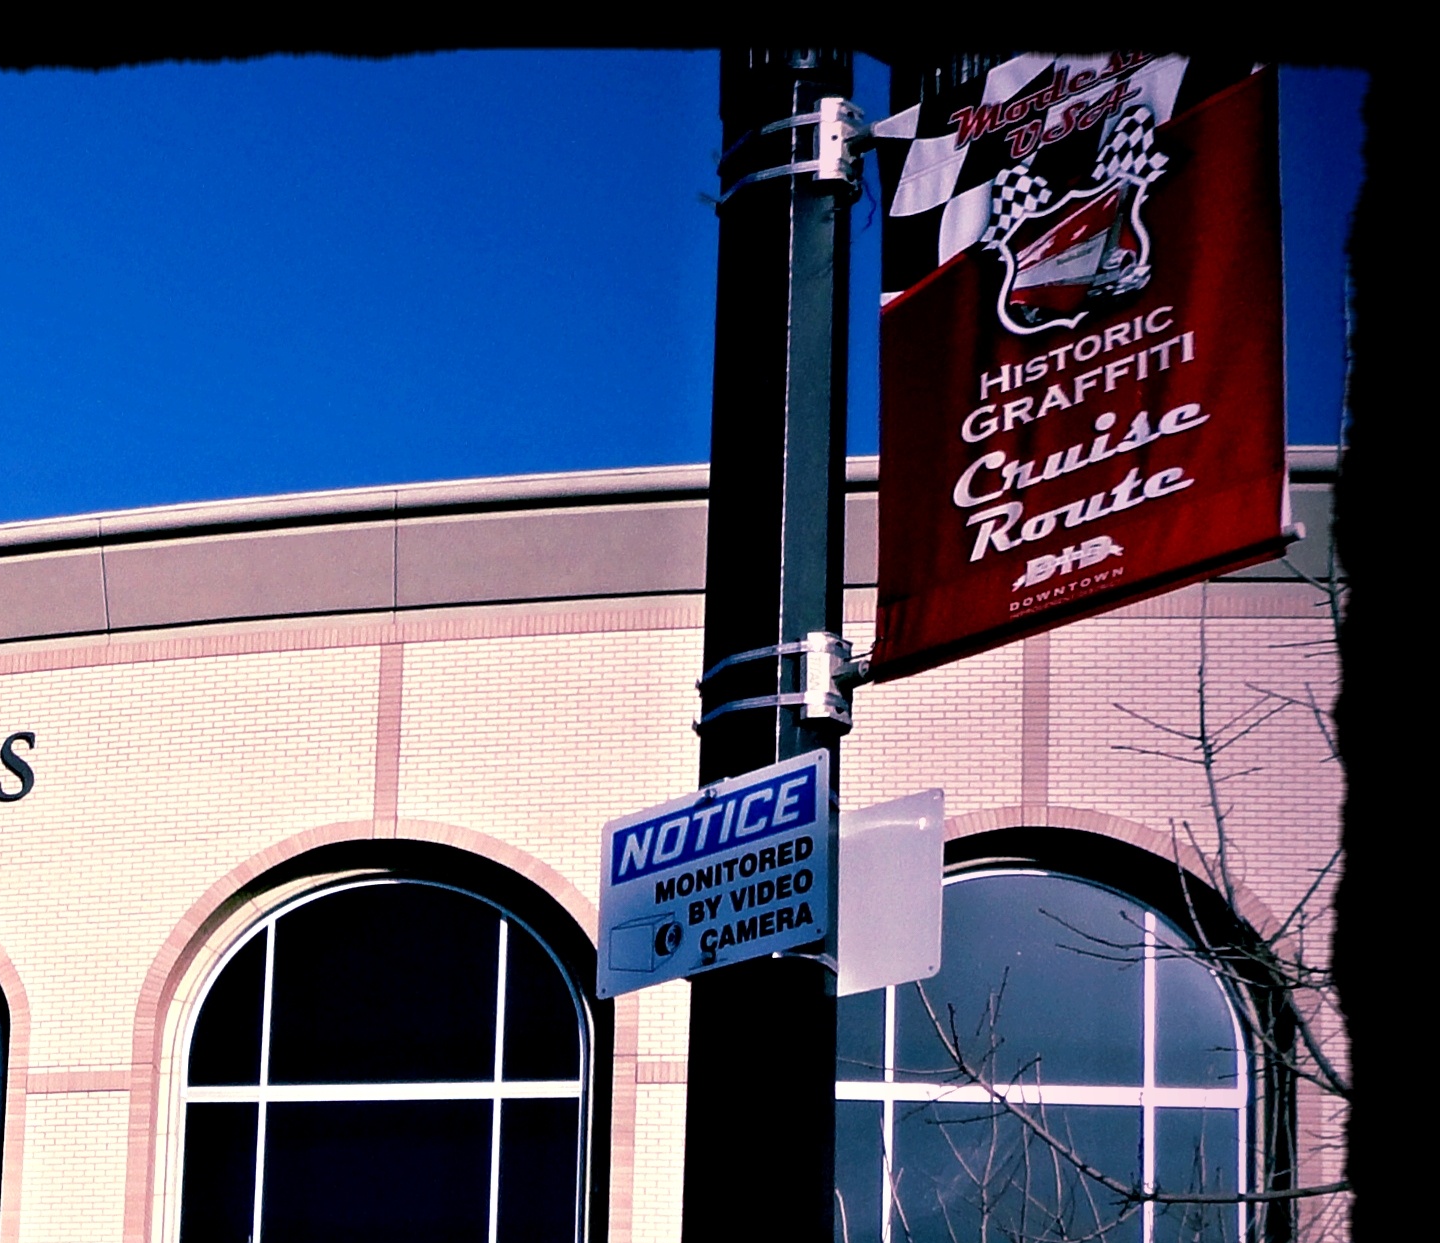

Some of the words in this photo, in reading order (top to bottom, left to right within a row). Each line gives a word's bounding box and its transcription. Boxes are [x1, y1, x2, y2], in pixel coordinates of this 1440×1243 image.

[960, 330, 1195, 445] GRAFFITI
[979, 305, 1174, 402] HISTORIC
[952, 402, 1211, 510] Cruise
[966, 465, 1196, 563] Route
[1009, 566, 1124, 612] DOWNTOWN
[617, 774, 809, 878] NOTICE
[654, 835, 814, 905] MONITORED
[688, 894, 722, 927] BY
[729, 868, 814, 913] VIDEO
[699, 902, 814, 953] CAMERA
